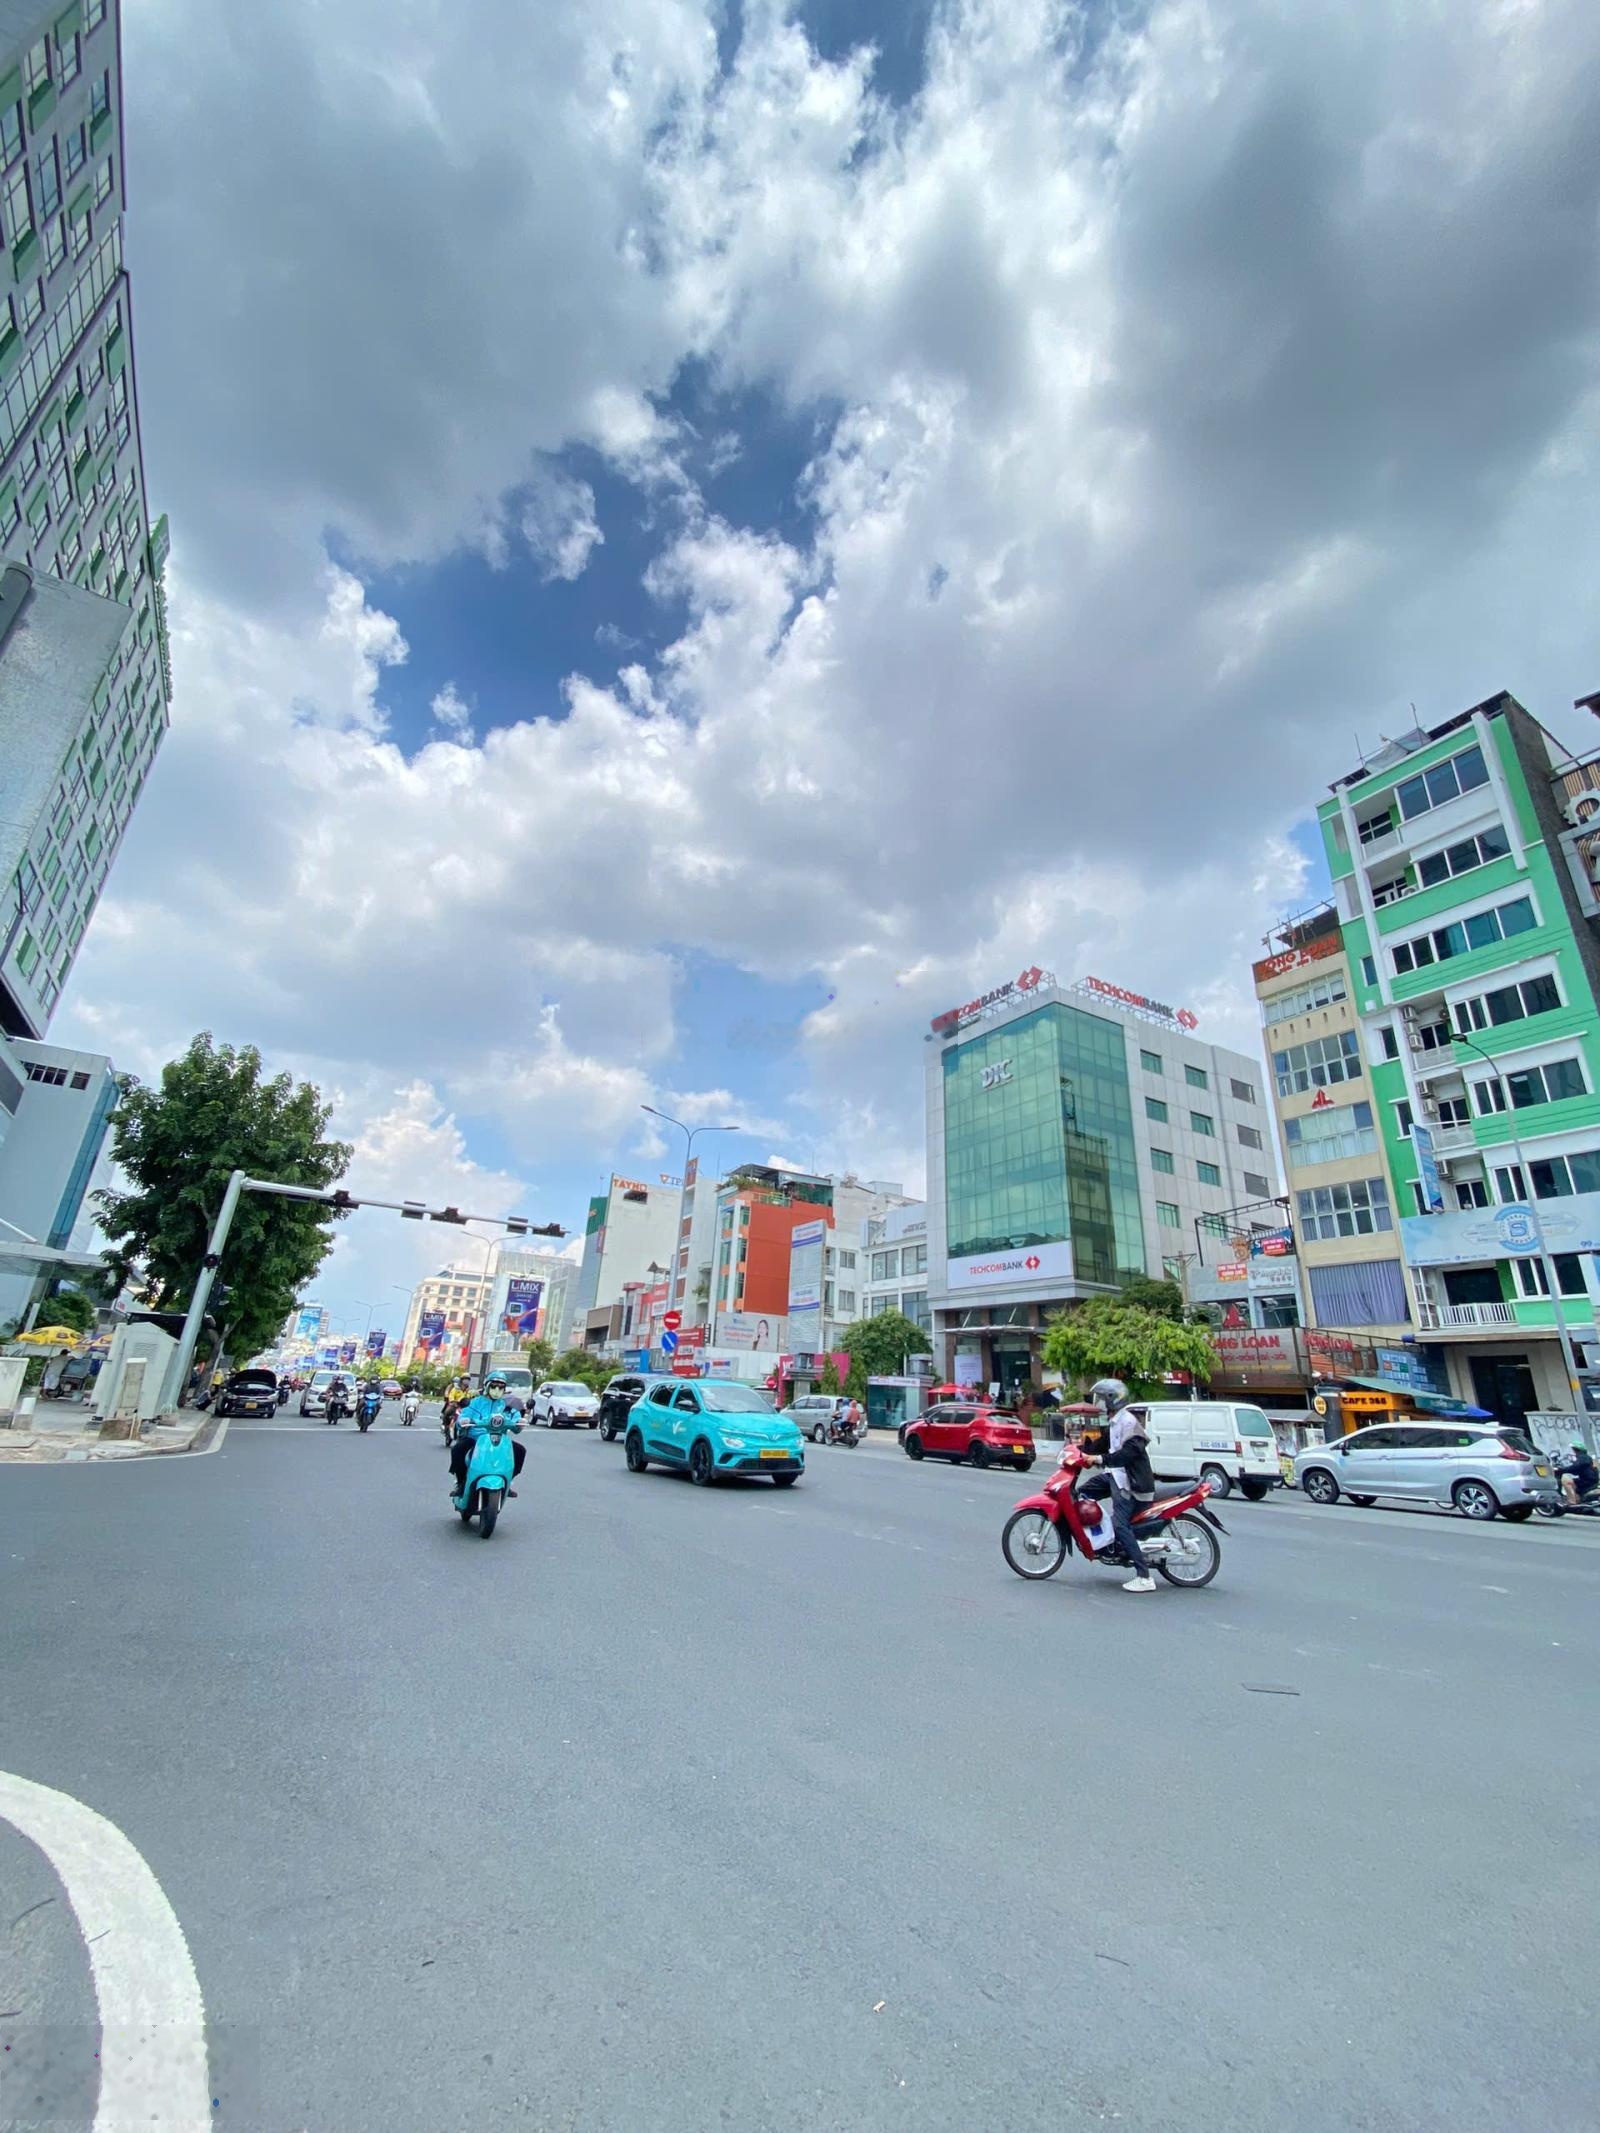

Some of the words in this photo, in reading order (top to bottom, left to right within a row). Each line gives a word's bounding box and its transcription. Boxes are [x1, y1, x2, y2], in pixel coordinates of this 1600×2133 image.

[1087, 976, 1175, 1019] TECHCOMBANK
[969, 1261, 1023, 1275] TECHCOMBANK
[1241, 1335, 1281, 1348] LOAN
